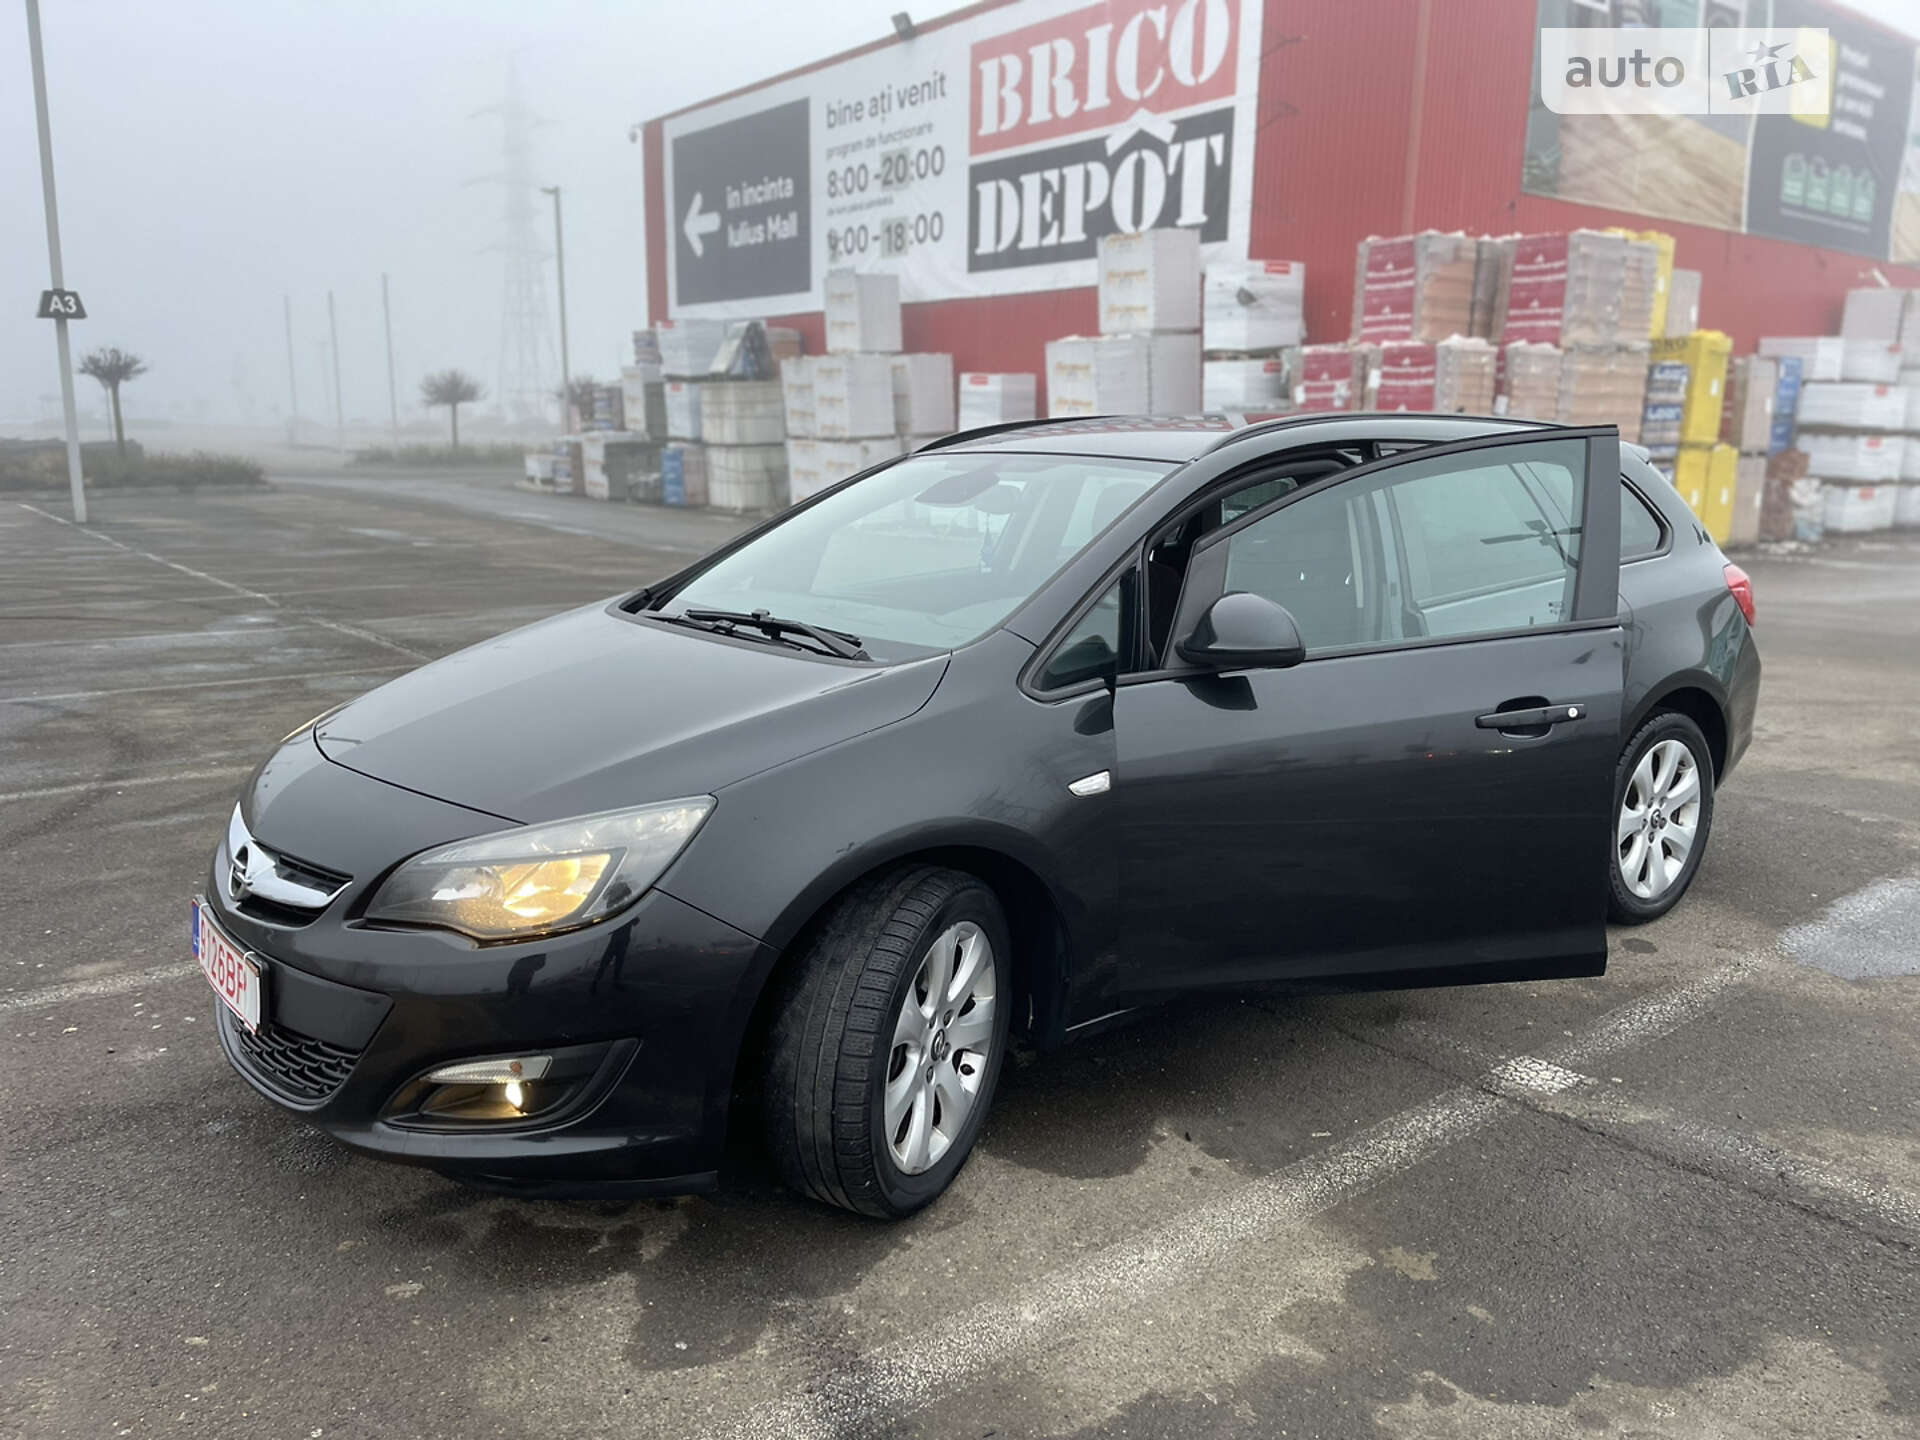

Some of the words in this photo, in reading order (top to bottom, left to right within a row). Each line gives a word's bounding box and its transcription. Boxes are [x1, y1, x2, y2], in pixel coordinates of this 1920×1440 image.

[826, 99, 864, 128] bine
[897, 71, 946, 109] venit
[977, 0, 1231, 136] BRICO
[974, 108, 1225, 256] DEPÔT
[49, 295, 77, 313] A3
